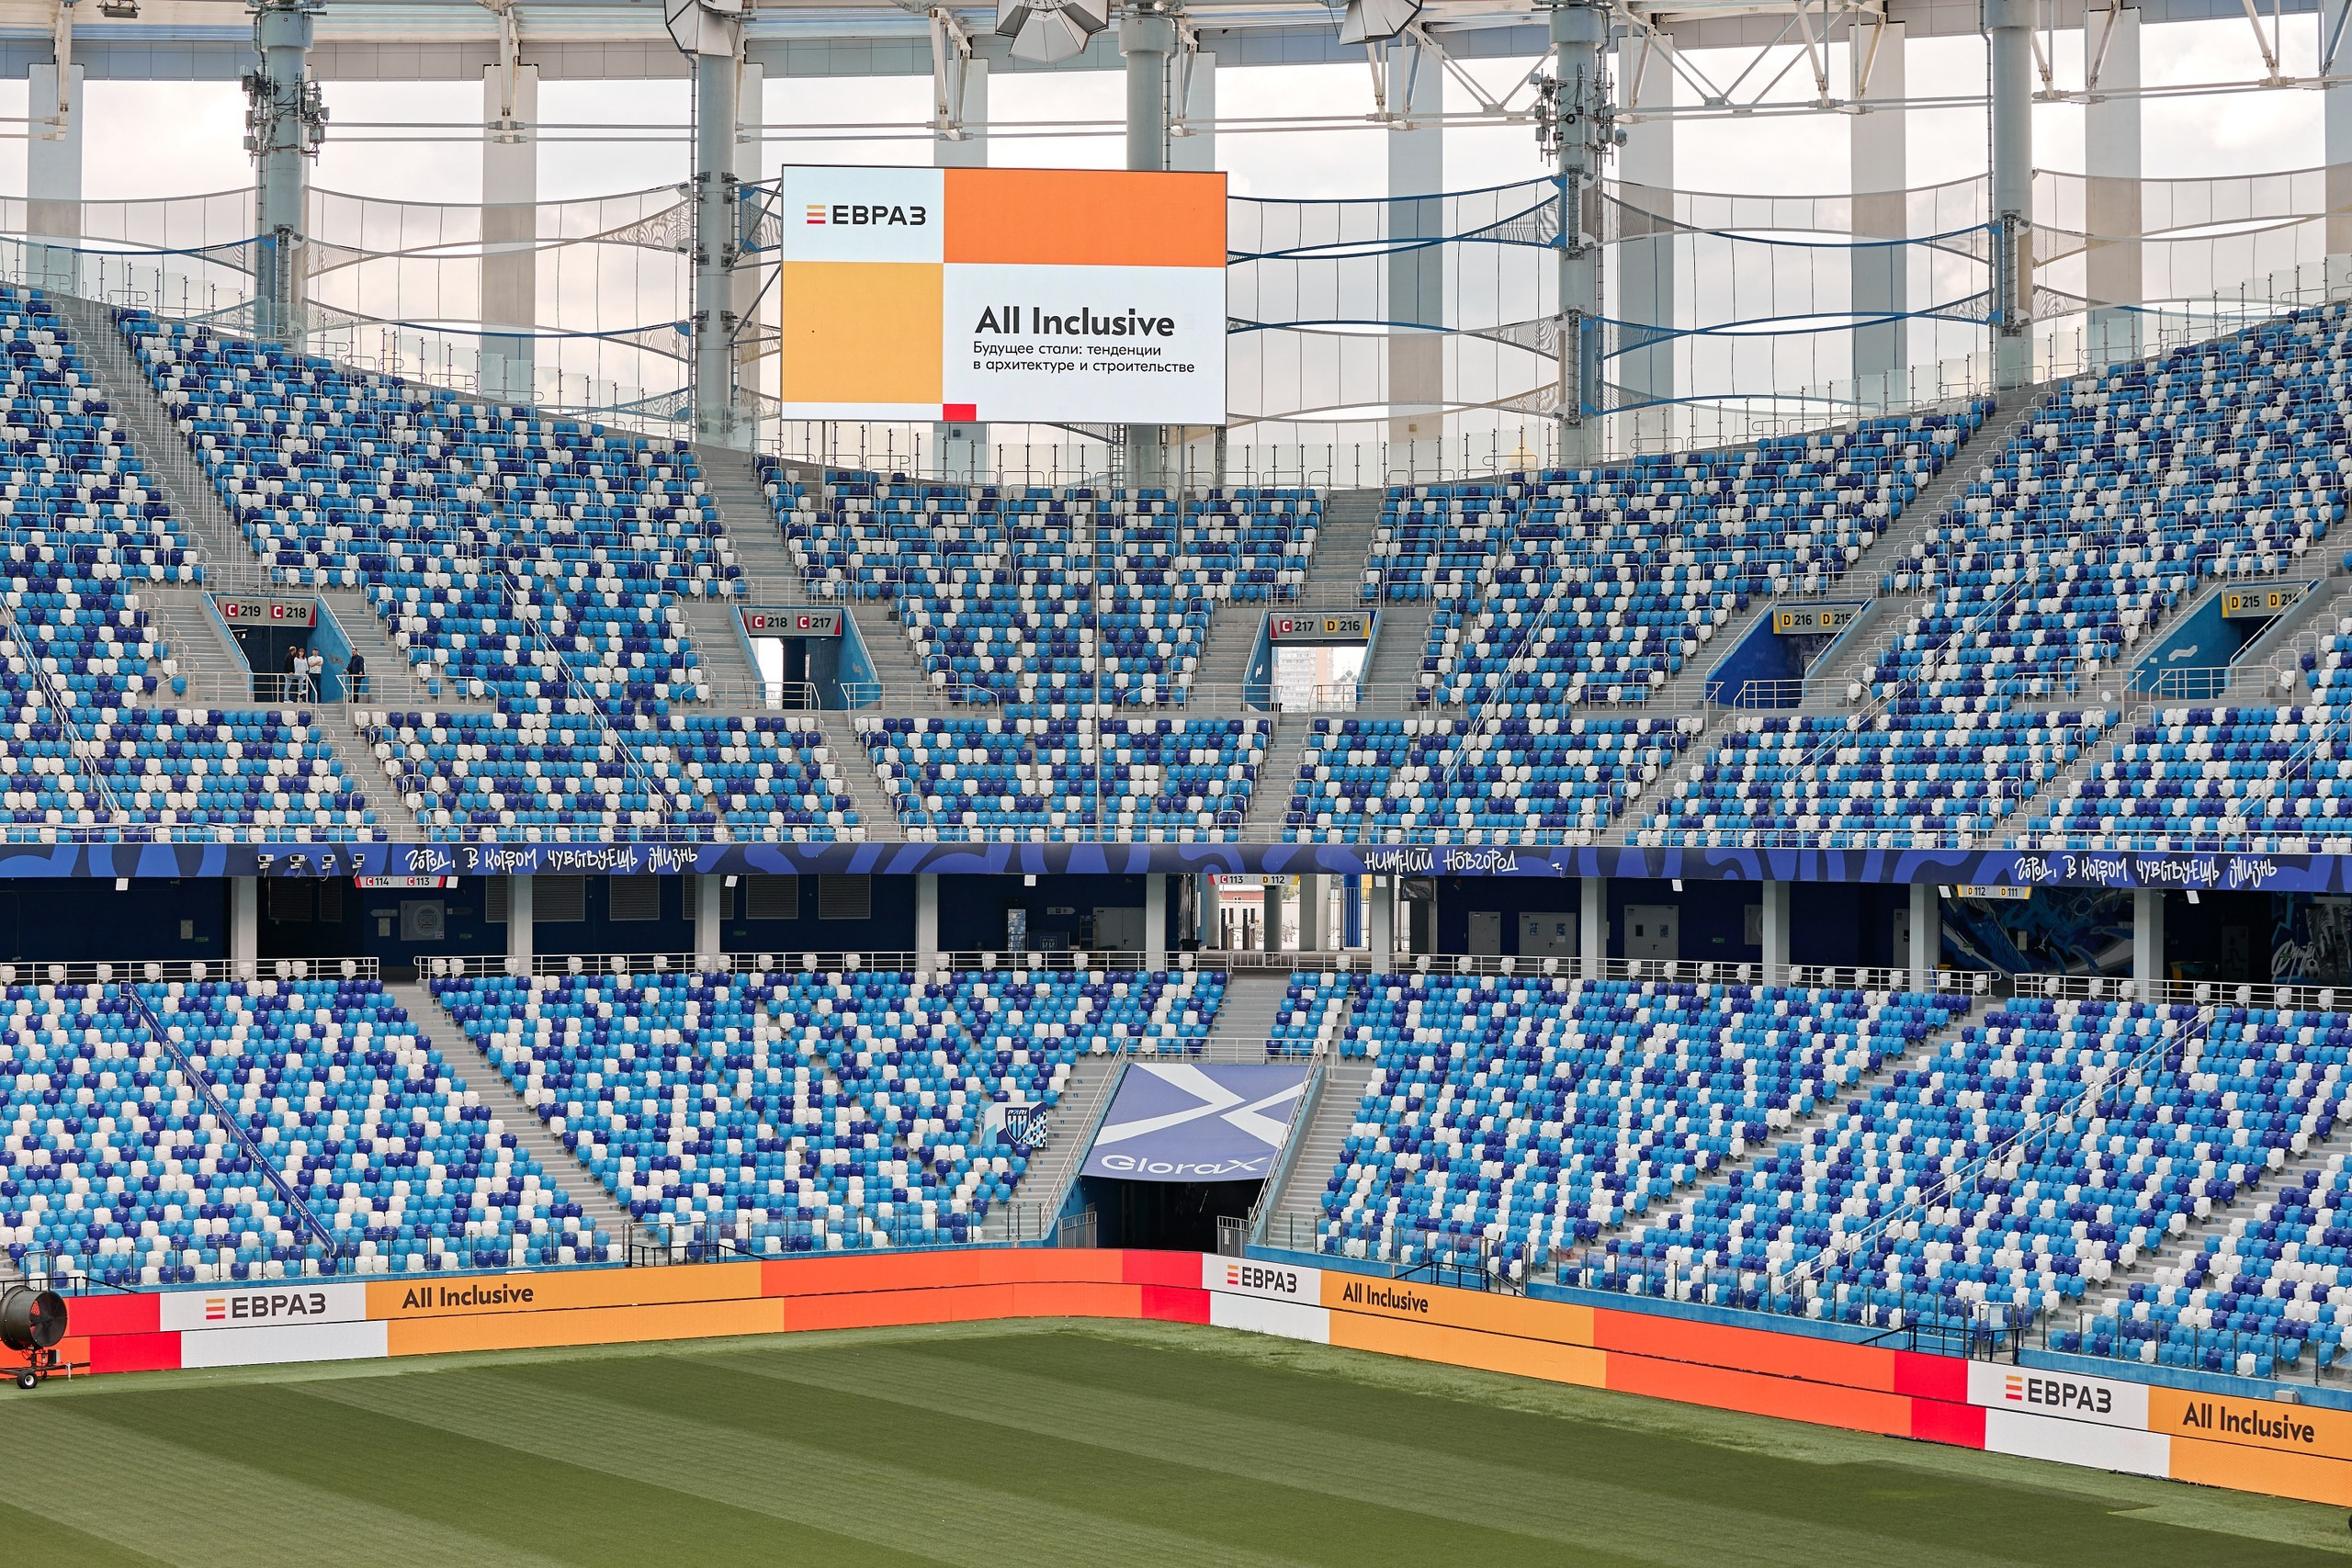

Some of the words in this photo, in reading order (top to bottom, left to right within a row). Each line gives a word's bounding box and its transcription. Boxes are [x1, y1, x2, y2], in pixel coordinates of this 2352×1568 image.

[832, 205, 926, 226] ЕВРАЗ
[974, 305, 1020, 334] All
[1033, 306, 1175, 337] Inclusive
[973, 341, 1035, 356] Будущее
[1038, 344, 1082, 355] стали:
[1087, 345, 1161, 357] тенденции
[973, 360, 981, 370] в
[985, 359, 1075, 374] архитектуре
[1080, 362, 1088, 371] и
[1092, 362, 1195, 374] строительстве
[2232, 596, 2239, 608] D
[2242, 595, 2260, 608] 215
[2270, 594, 2278, 606] D
[227, 604, 236, 616] C
[240, 605, 261, 617] 219
[273, 606, 281, 618] C
[286, 607, 307, 619] 218
[754, 616, 763, 627] C
[767, 616, 787, 627] 218
[799, 616, 808, 627] C
[812, 617, 831, 628] 217
[1327, 621, 1335, 631] D
[1340, 620, 1361, 631] 216
[1783, 615, 1791, 626] D
[1794, 614, 1813, 626] 216
[1823, 614, 1830, 625] D
[1834, 613, 1851, 625] 215
[1282, 621, 1290, 632] C
[1295, 621, 1315, 632] 217
[1229, 875, 1244, 884] 113
[1271, 875, 1285, 884] 112
[1968, 887, 1973, 896] D
[1974, 886, 1986, 897] 112
[2001, 887, 2007, 896] D
[2007, 888, 2018, 897] 111
[1101, 1153, 1268, 1178] GloraX
[1241, 1266, 1297, 1293] ЕВРАЗ
[401, 1287, 434, 1309] All
[440, 1283, 534, 1307] Inclusive
[1342, 1281, 1363, 1304] All
[1366, 1284, 1429, 1314] Inclusive
[232, 1292, 326, 1319] ЕВРАЗ
[2028, 1377, 2112, 1414] ЕВРАЗ
[2182, 1402, 2212, 1429] All
[2220, 1405, 2315, 1444] Inclusive
